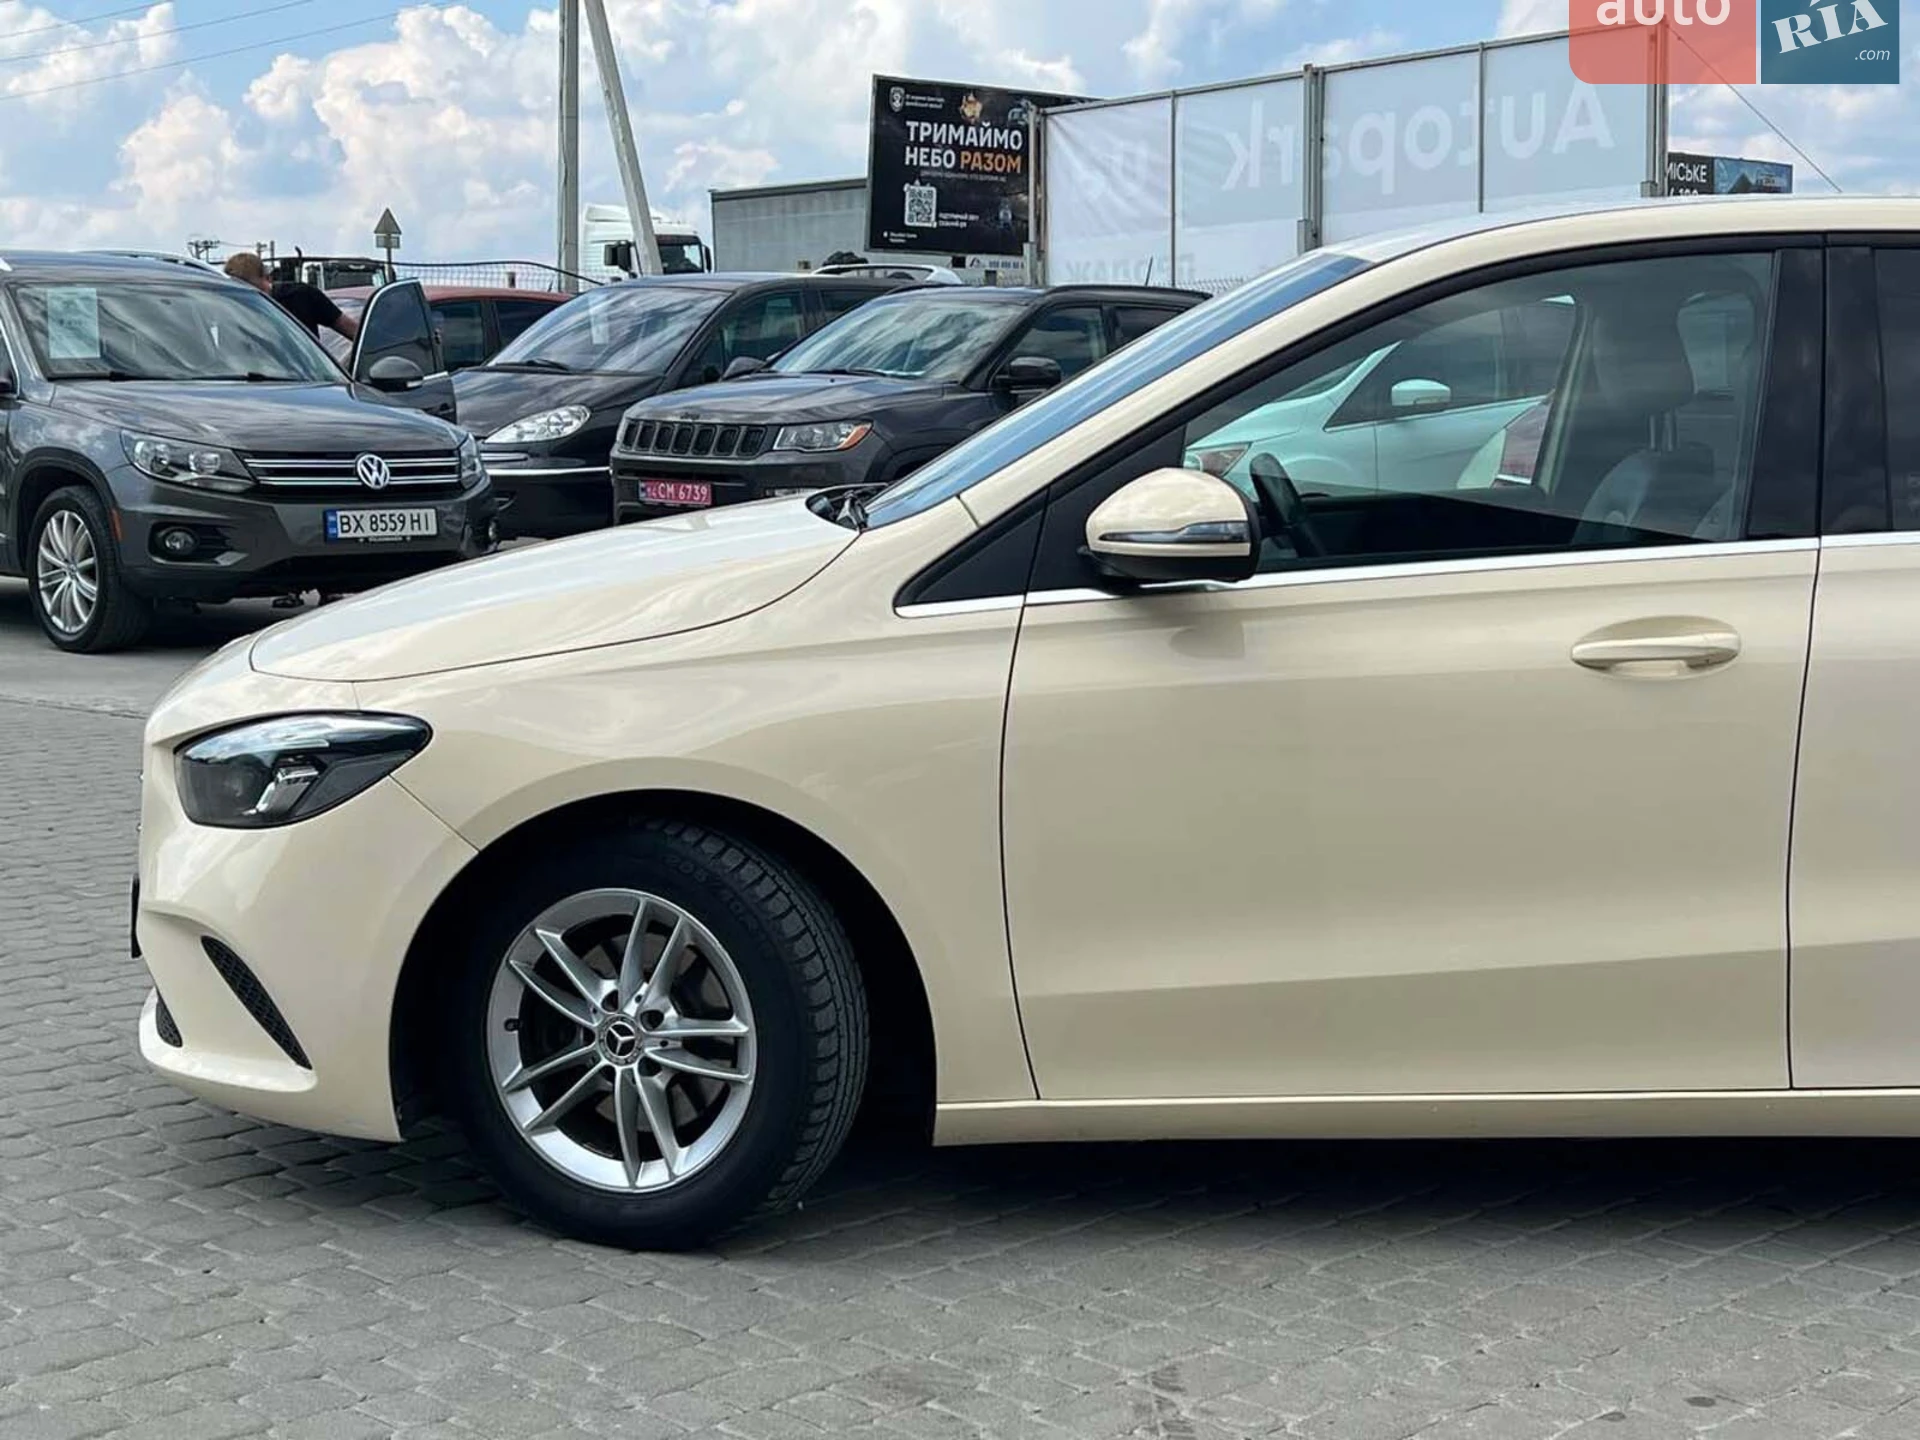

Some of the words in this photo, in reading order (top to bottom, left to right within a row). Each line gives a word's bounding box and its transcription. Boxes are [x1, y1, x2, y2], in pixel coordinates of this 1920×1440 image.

[905, 120, 1023, 150] ТРИМАЙМО
[904, 146, 956, 169] НЕБО
[960, 151, 1022, 174] РАЗОМ
[678, 483, 708, 502] 6739
[339, 514, 365, 534] BX
[369, 513, 406, 533] 8559
[410, 511, 429, 532] HI
